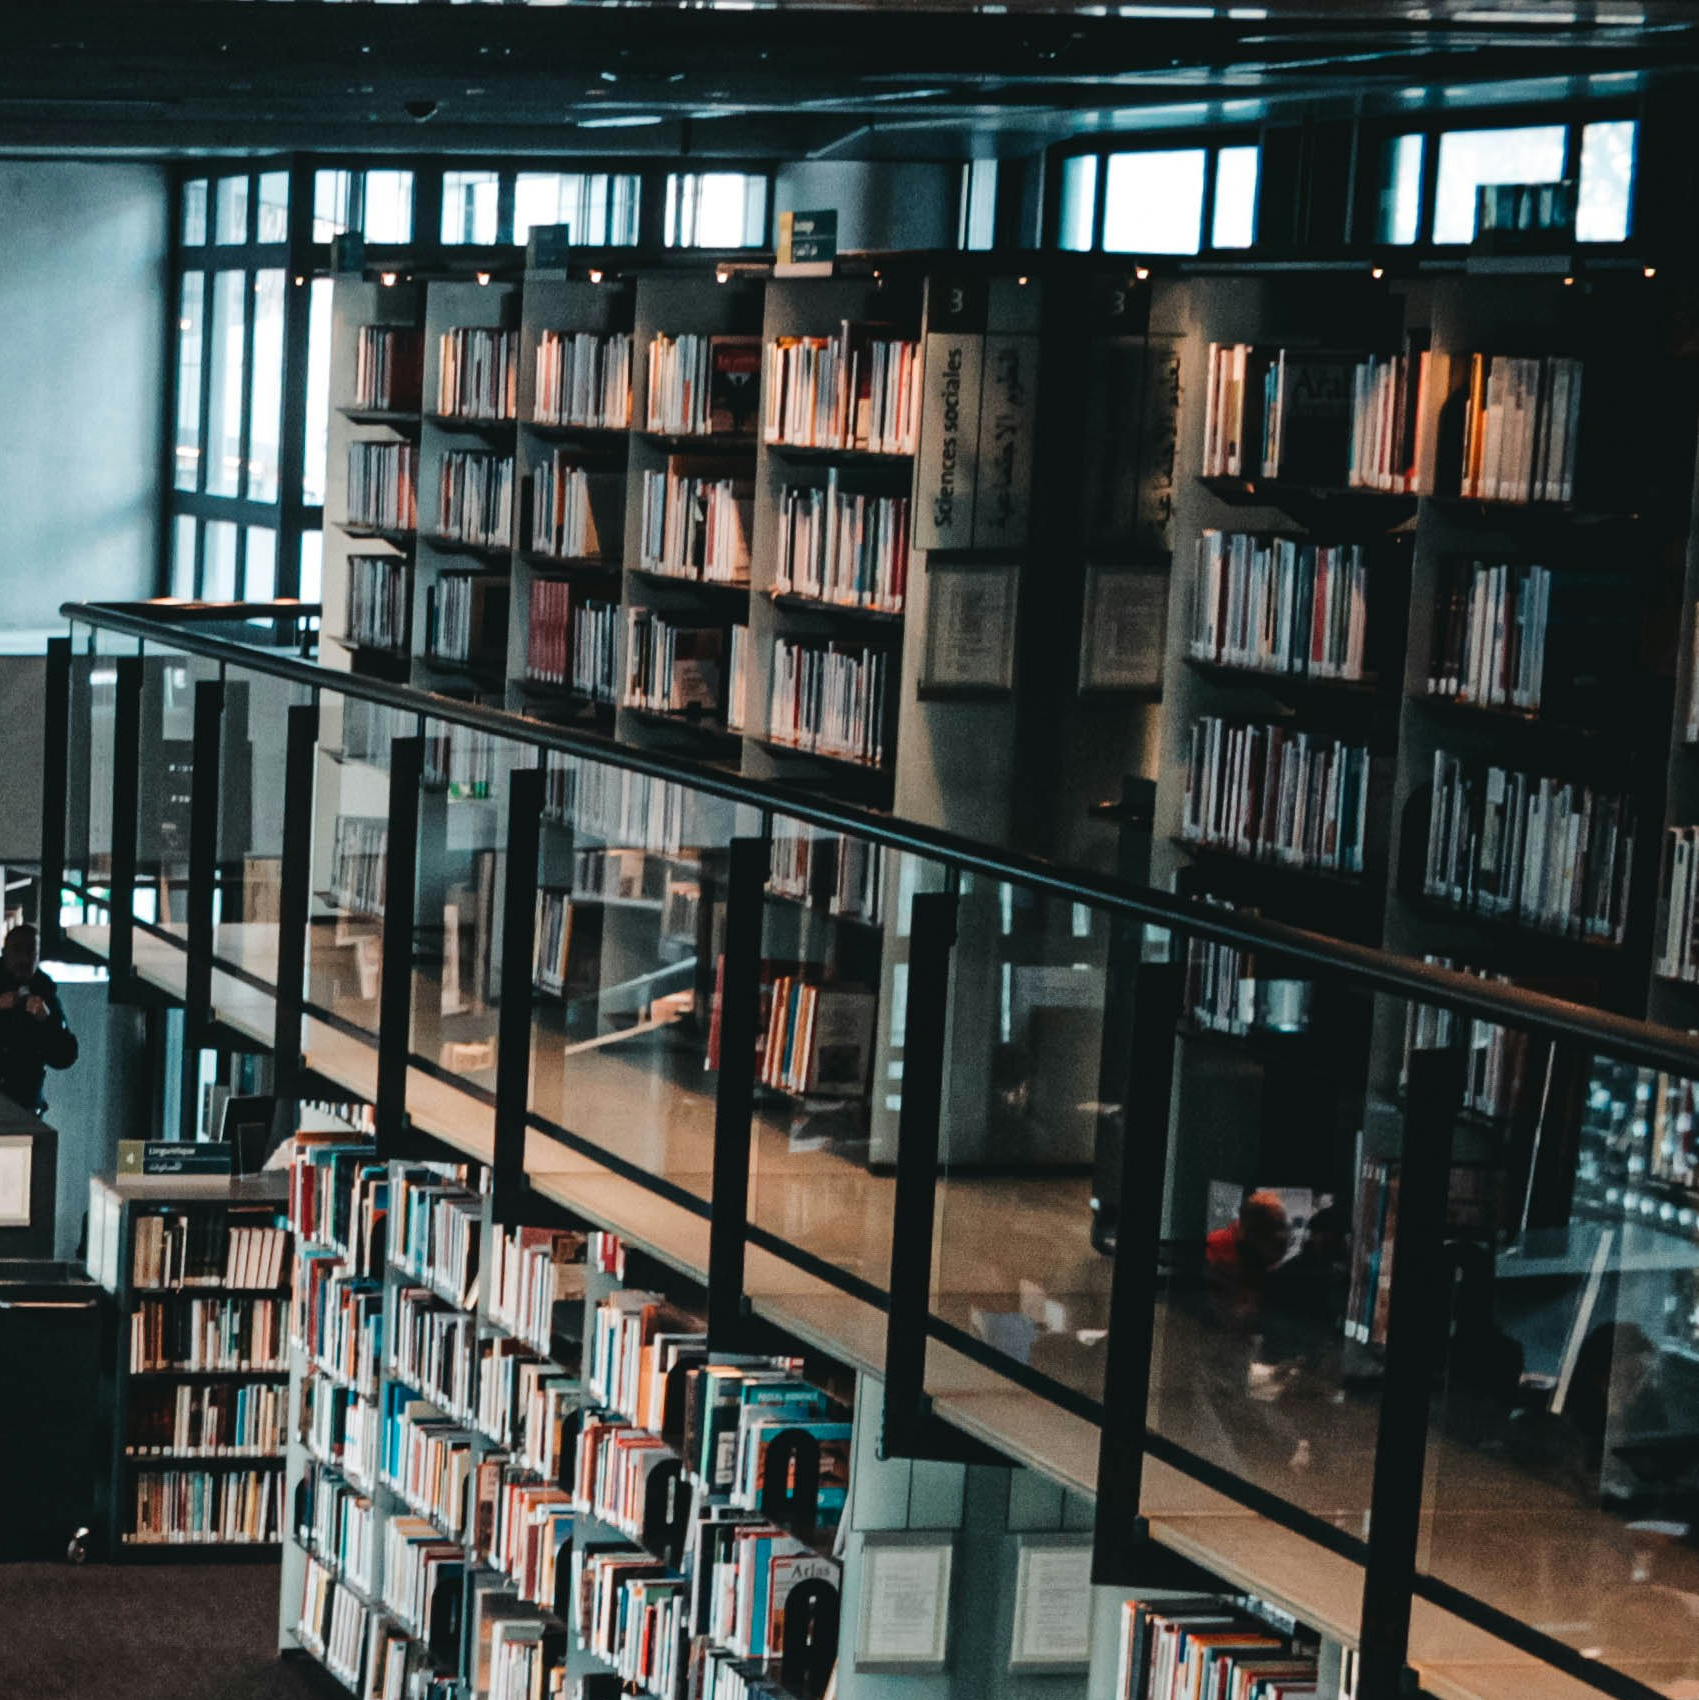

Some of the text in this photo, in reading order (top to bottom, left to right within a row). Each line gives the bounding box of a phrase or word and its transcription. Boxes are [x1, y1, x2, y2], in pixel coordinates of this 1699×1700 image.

[934, 348, 963, 528] Sciences sociales
[791, 1562, 830, 1579] Atlas
